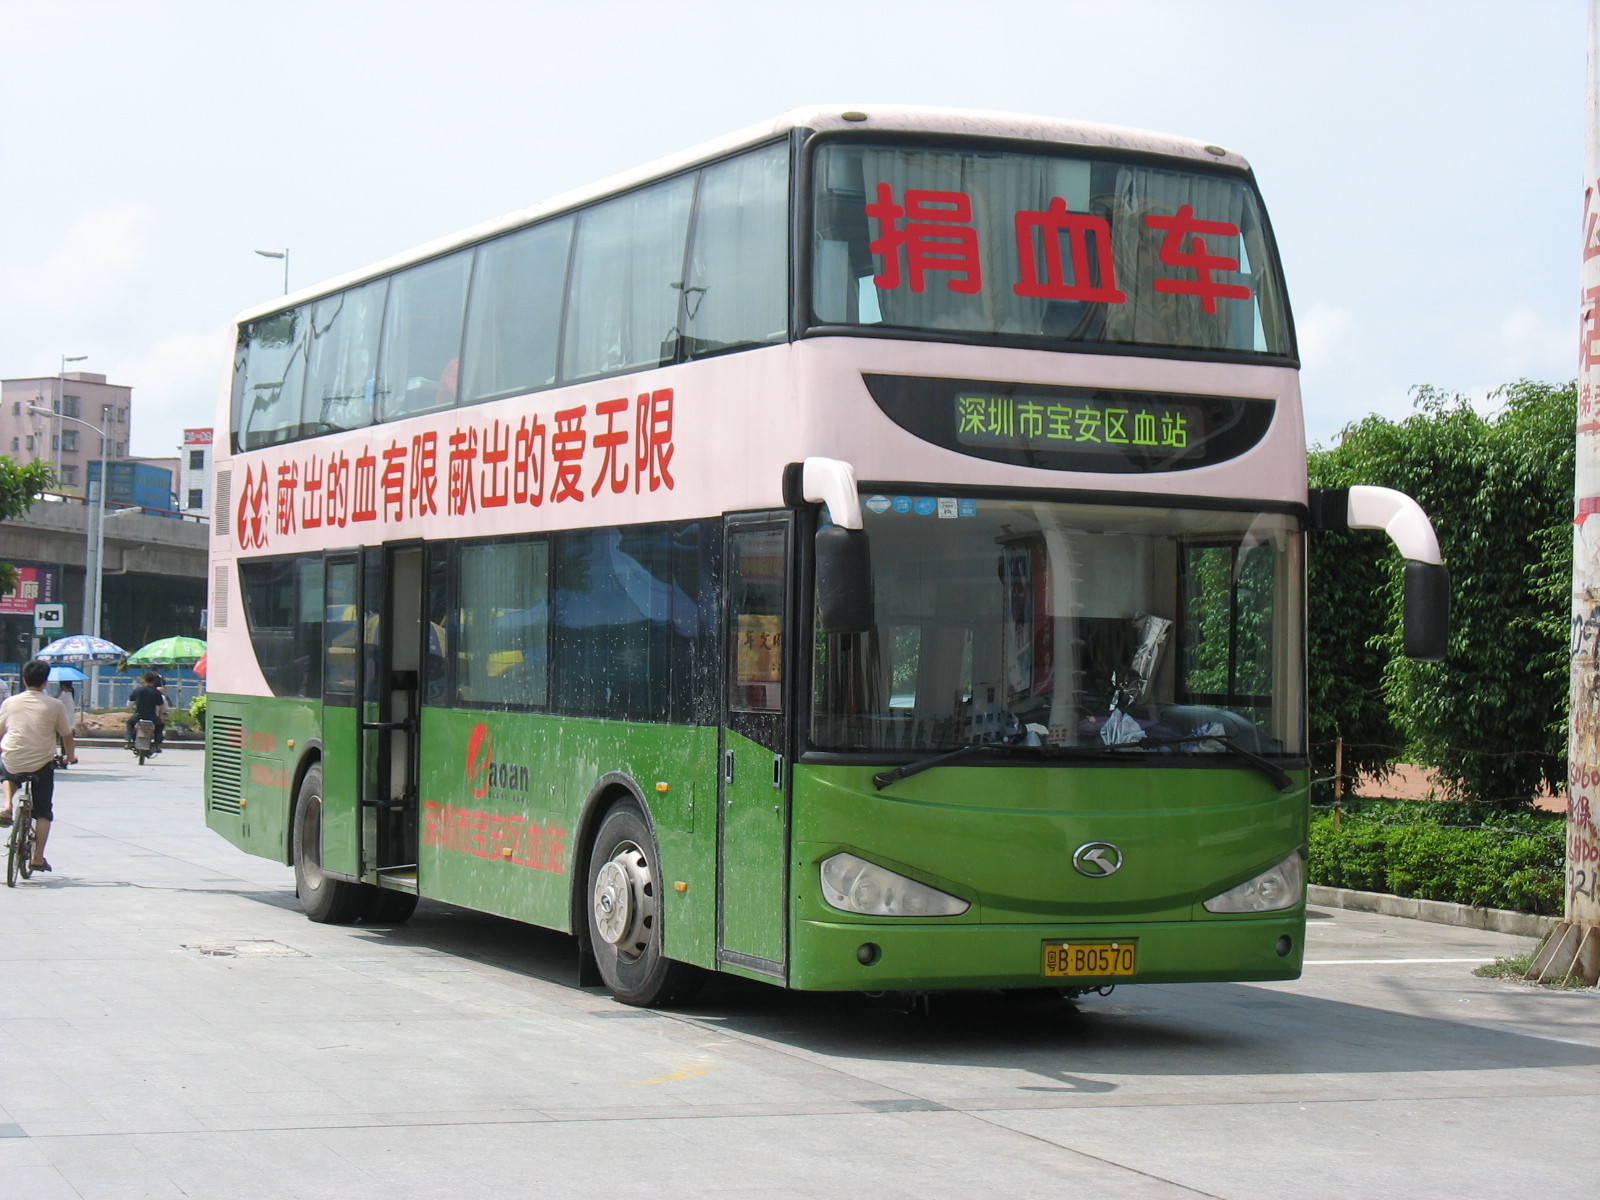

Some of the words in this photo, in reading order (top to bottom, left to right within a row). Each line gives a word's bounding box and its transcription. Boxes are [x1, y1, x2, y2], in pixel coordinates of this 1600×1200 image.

[865, 182, 1252, 315] 捐血车
[275, 431, 438, 535] 献出的血有限
[447, 387, 675, 516] 献出的爱无限
[958, 397, 1188, 448] 深圳市宝安区血站
